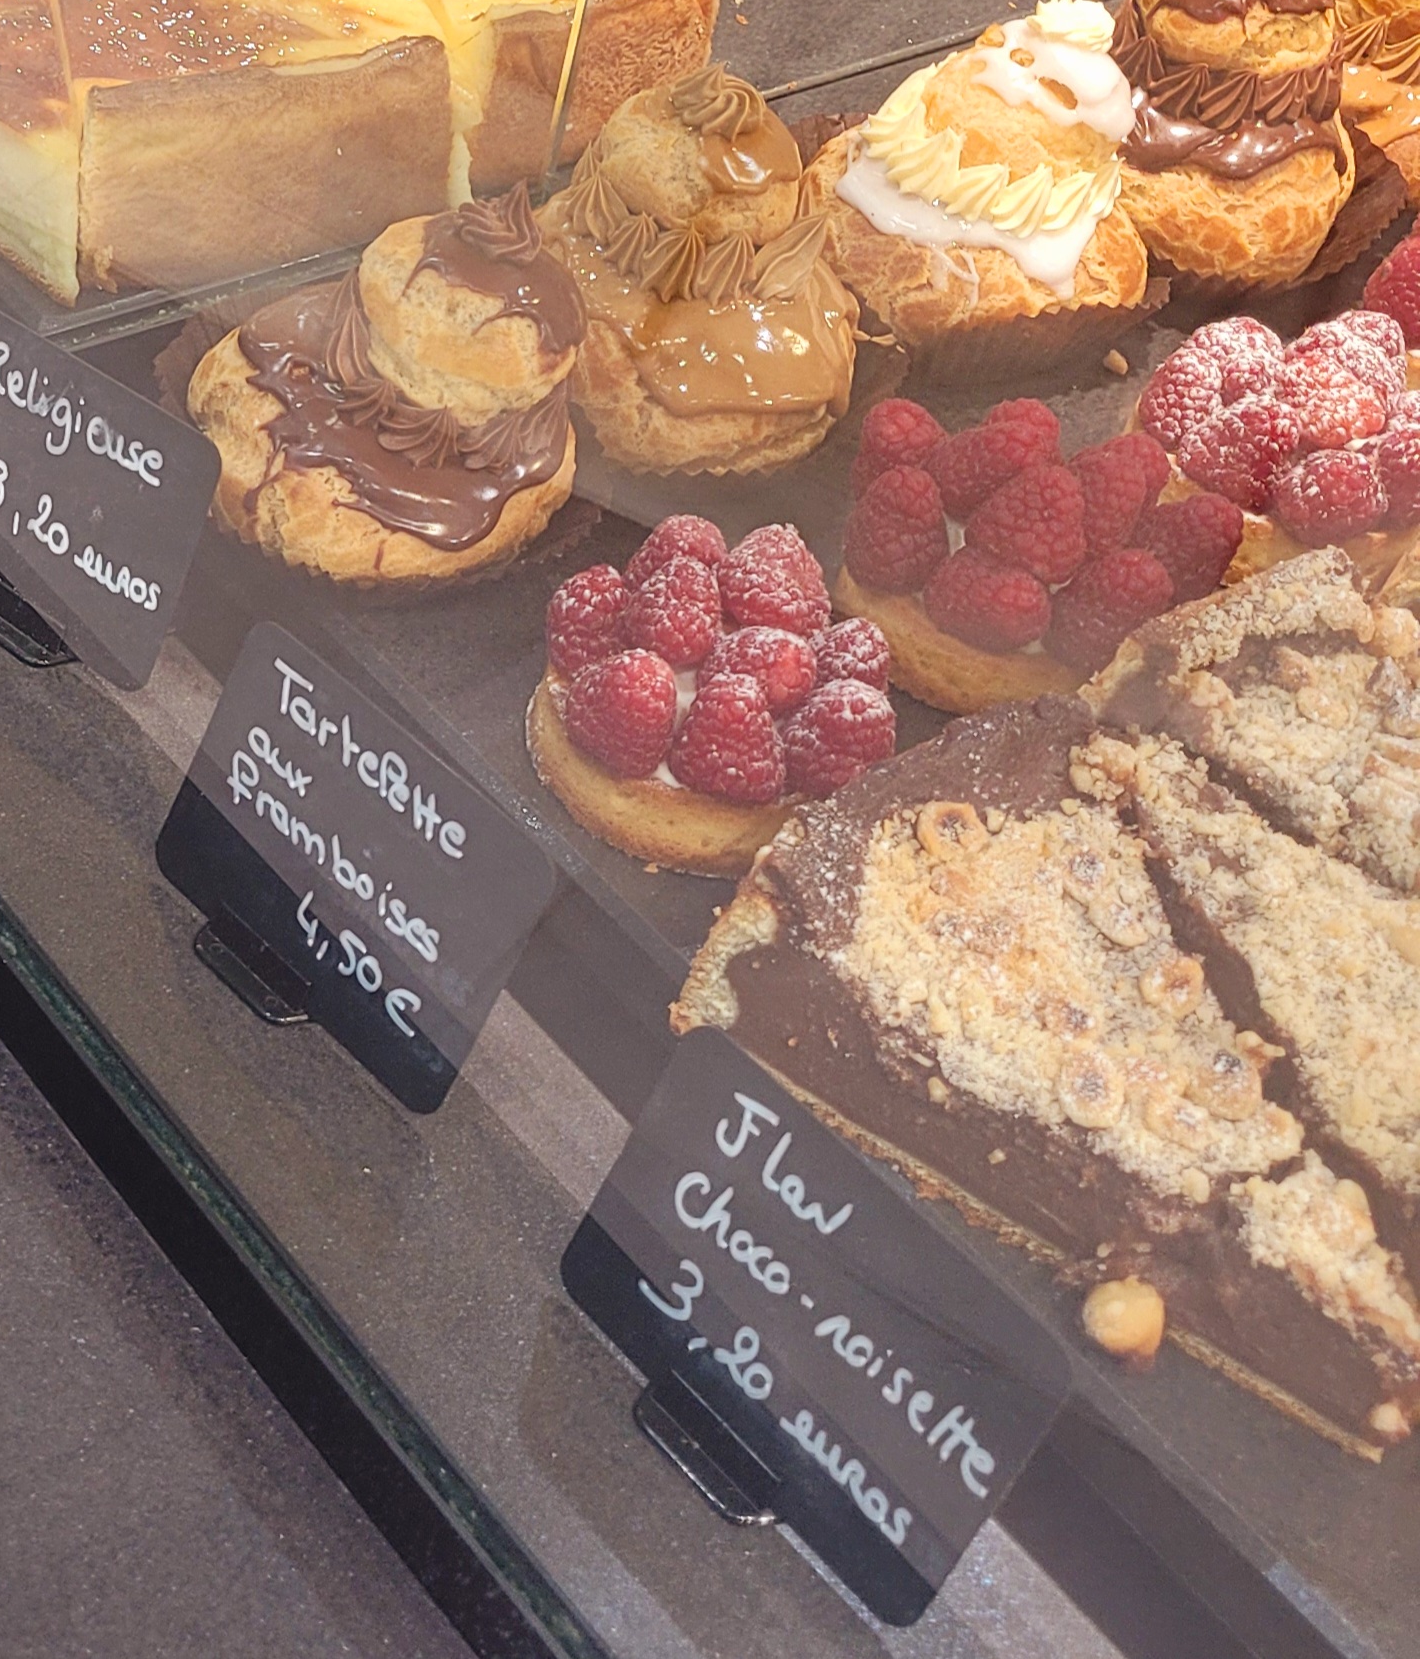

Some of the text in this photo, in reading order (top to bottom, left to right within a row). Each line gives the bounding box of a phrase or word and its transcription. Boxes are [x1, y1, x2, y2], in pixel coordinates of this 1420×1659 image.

[73, 545, 162, 612] euros
[246, 726, 313, 798] aux
[638, 1259, 915, 1546] 3,20 euros
